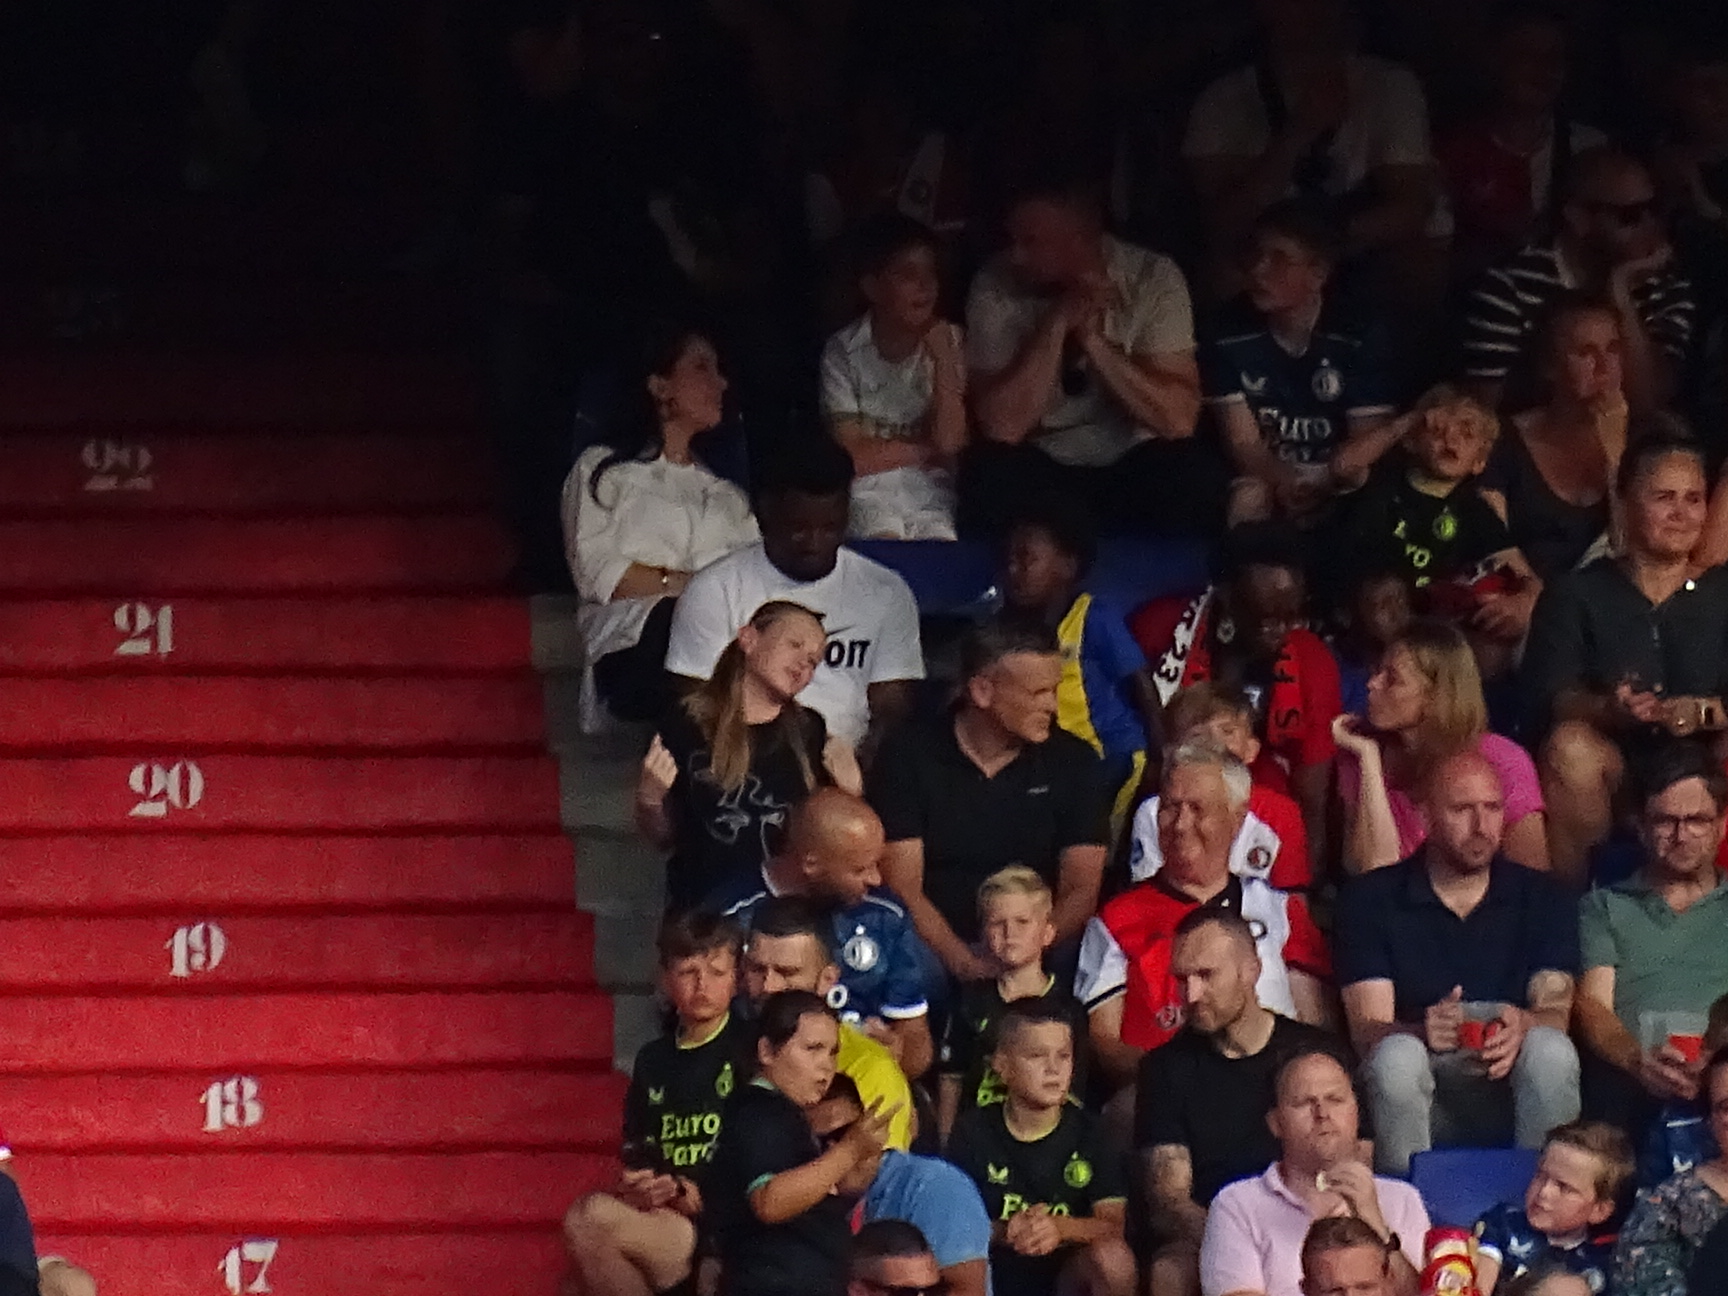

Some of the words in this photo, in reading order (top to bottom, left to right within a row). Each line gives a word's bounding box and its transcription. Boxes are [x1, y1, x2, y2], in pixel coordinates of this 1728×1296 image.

[113, 602, 176, 656] 21
[127, 760, 205, 818] 20
[164, 921, 228, 978] 19
[200, 1075, 264, 1134] 18
[661, 1112, 722, 1141] Euro
[220, 1238, 280, 1296] 17
